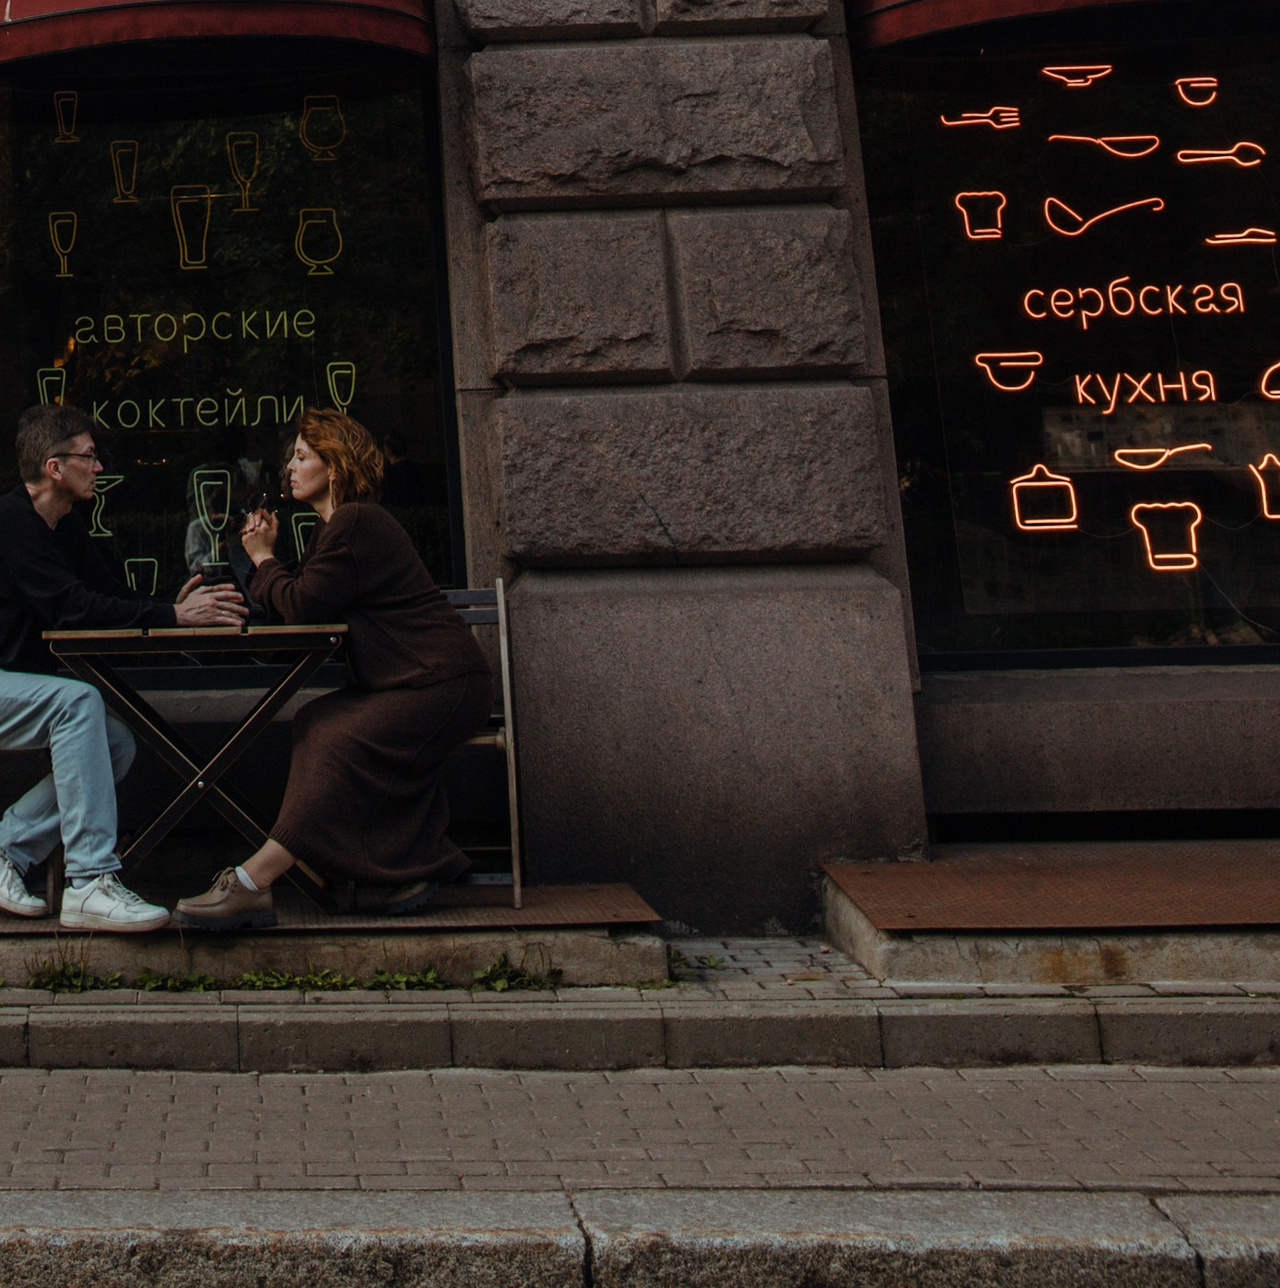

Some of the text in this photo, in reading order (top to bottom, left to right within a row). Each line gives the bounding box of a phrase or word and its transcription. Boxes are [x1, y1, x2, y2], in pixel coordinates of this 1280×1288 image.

[1023, 275, 1246, 331] сербская
[74, 308, 317, 355] авторские
[92, 387, 305, 429] коктейли
[1074, 369, 1218, 415] кухня
